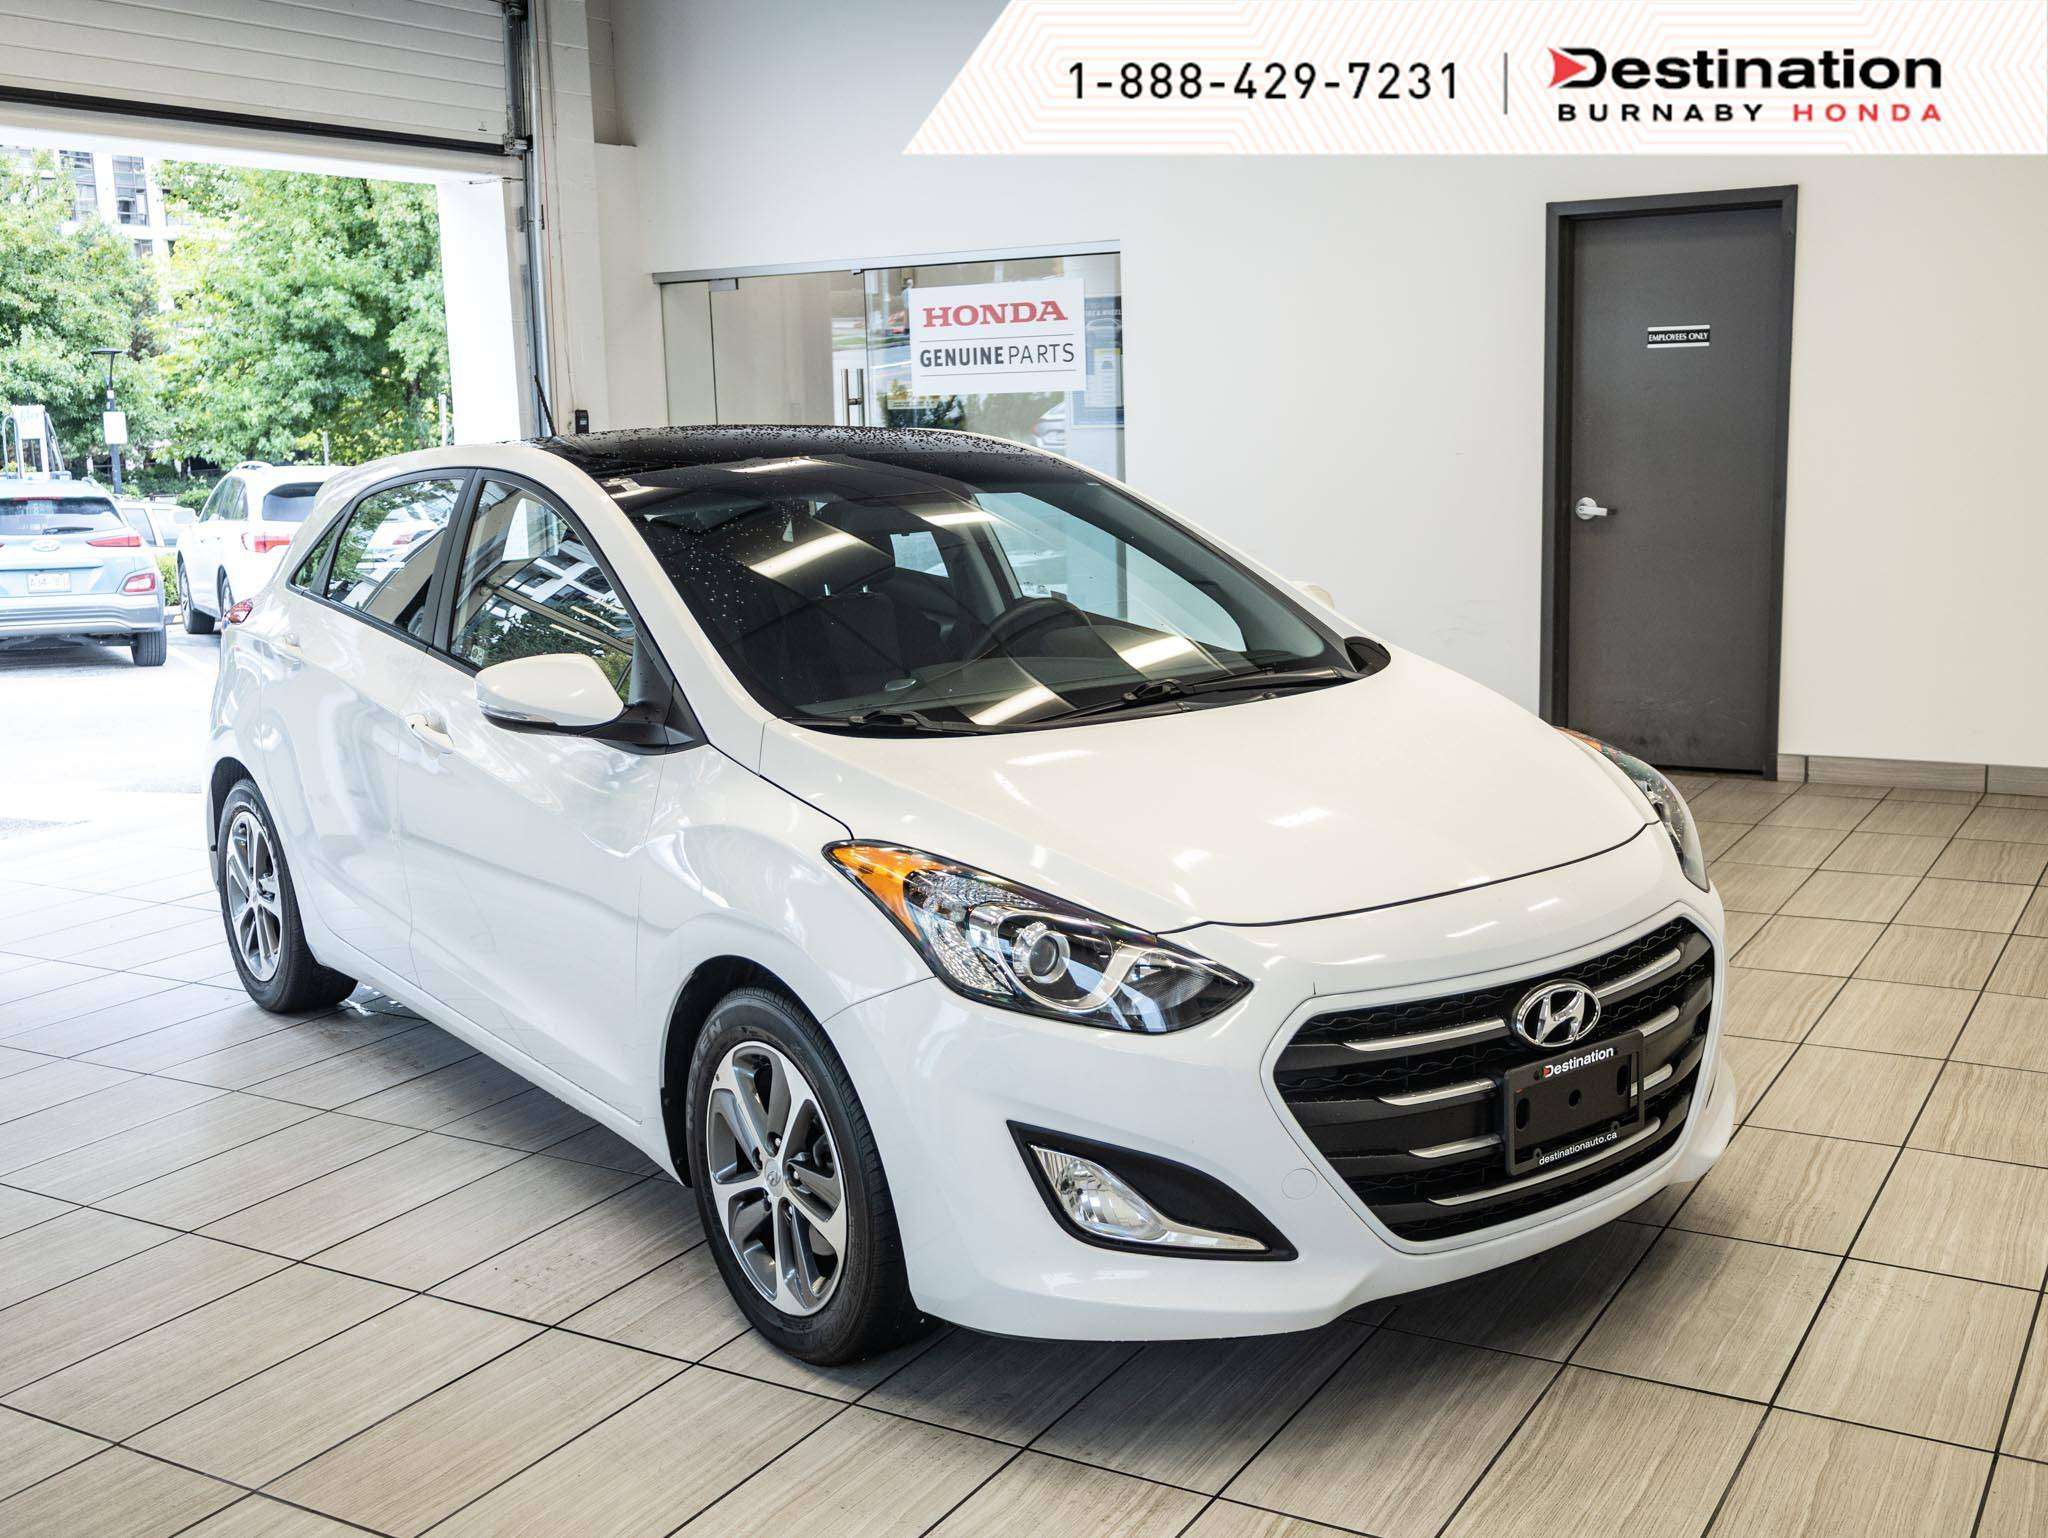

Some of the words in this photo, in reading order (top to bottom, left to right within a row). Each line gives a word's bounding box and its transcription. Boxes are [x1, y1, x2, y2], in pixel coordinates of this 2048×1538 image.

[922, 300, 1069, 328] HONDA
[1648, 333, 1687, 341] EMPLOYEES
[1688, 332, 1709, 340] ONLY
[1543, 1047, 1614, 1078] Destination
[1539, 1132, 1617, 1165] destinationauto.ca
